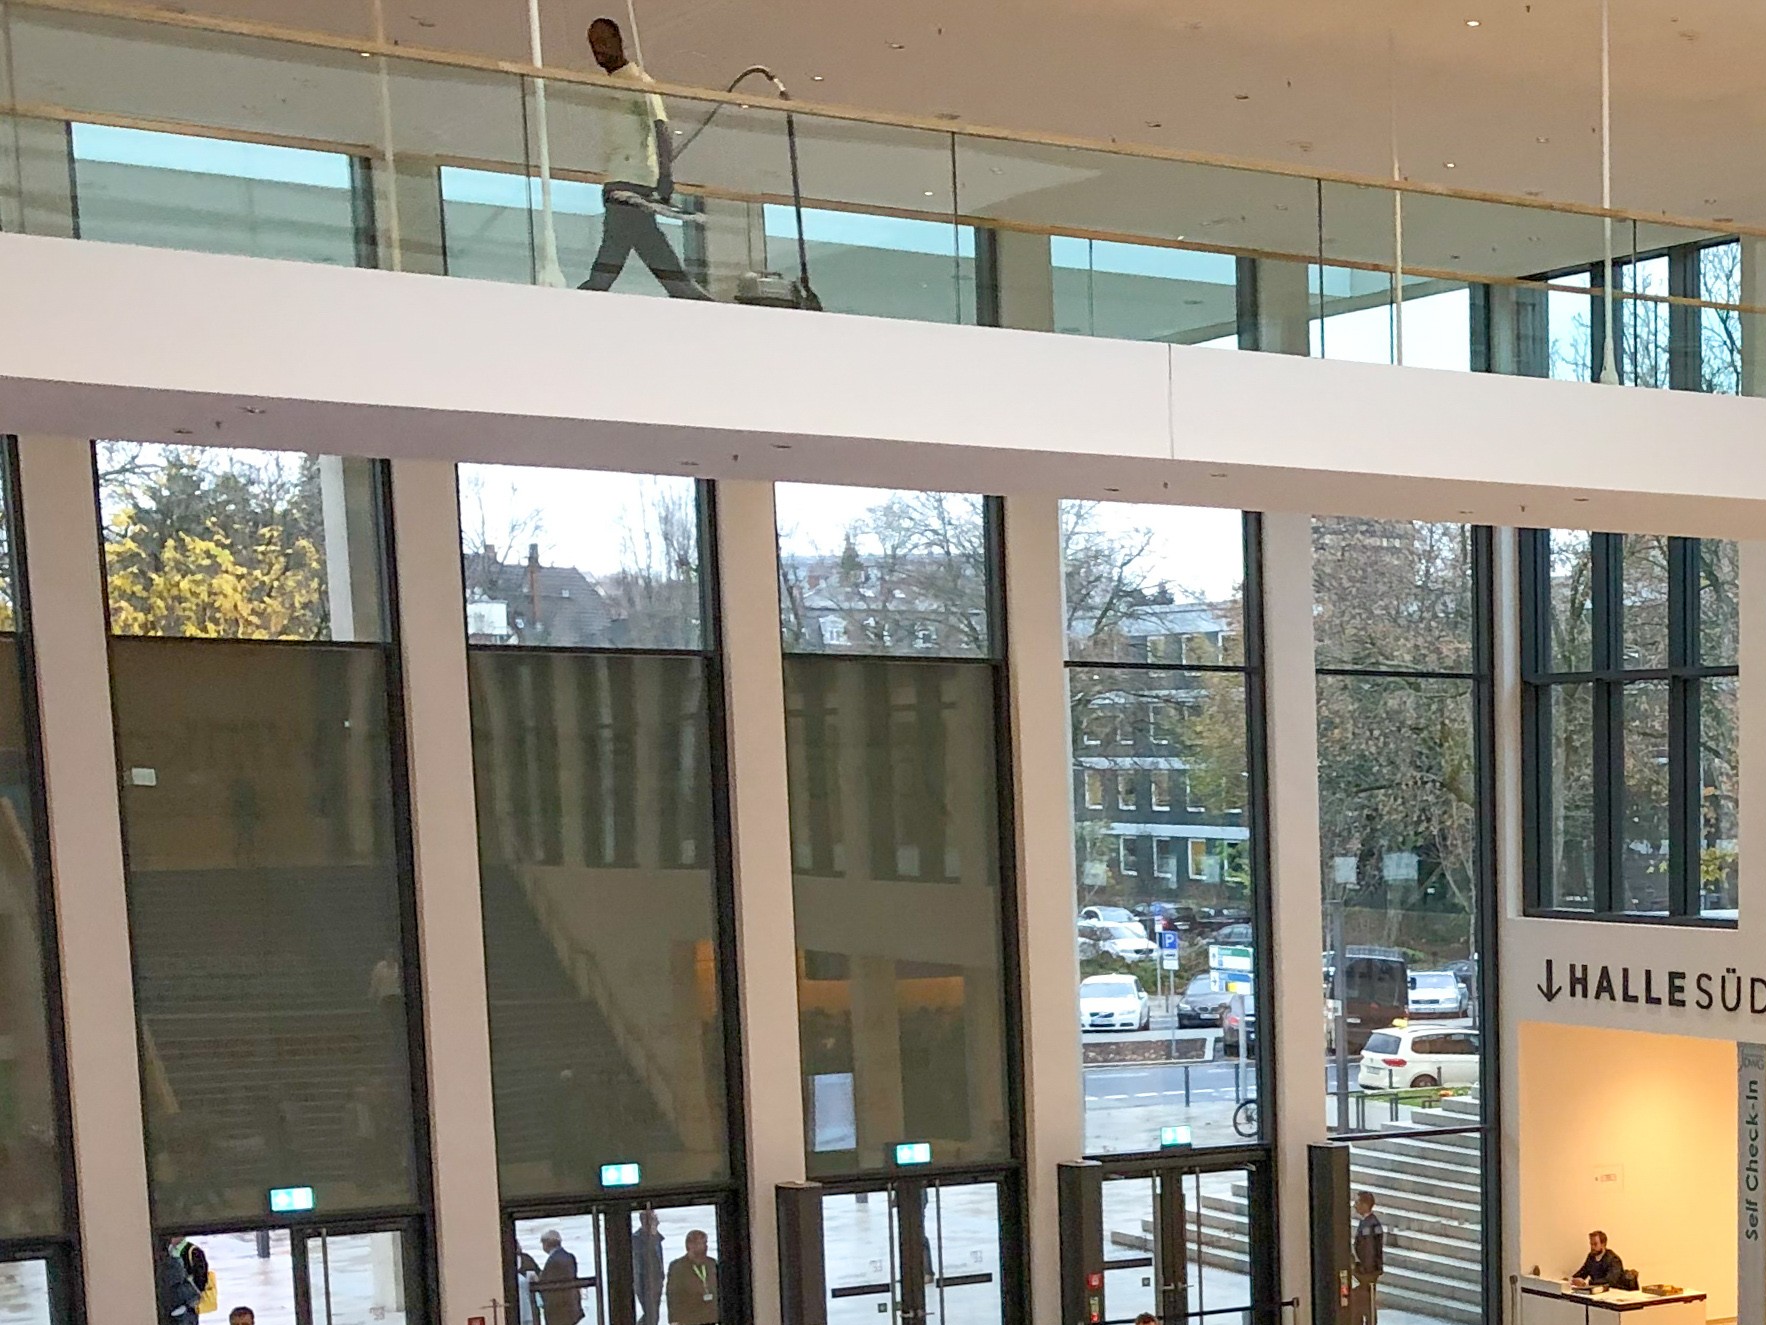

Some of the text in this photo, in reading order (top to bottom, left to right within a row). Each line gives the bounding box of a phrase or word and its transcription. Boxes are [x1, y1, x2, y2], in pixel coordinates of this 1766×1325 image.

[1164, 933, 1175, 948] P
[1745, 1079, 1759, 1241] Self Check-In
